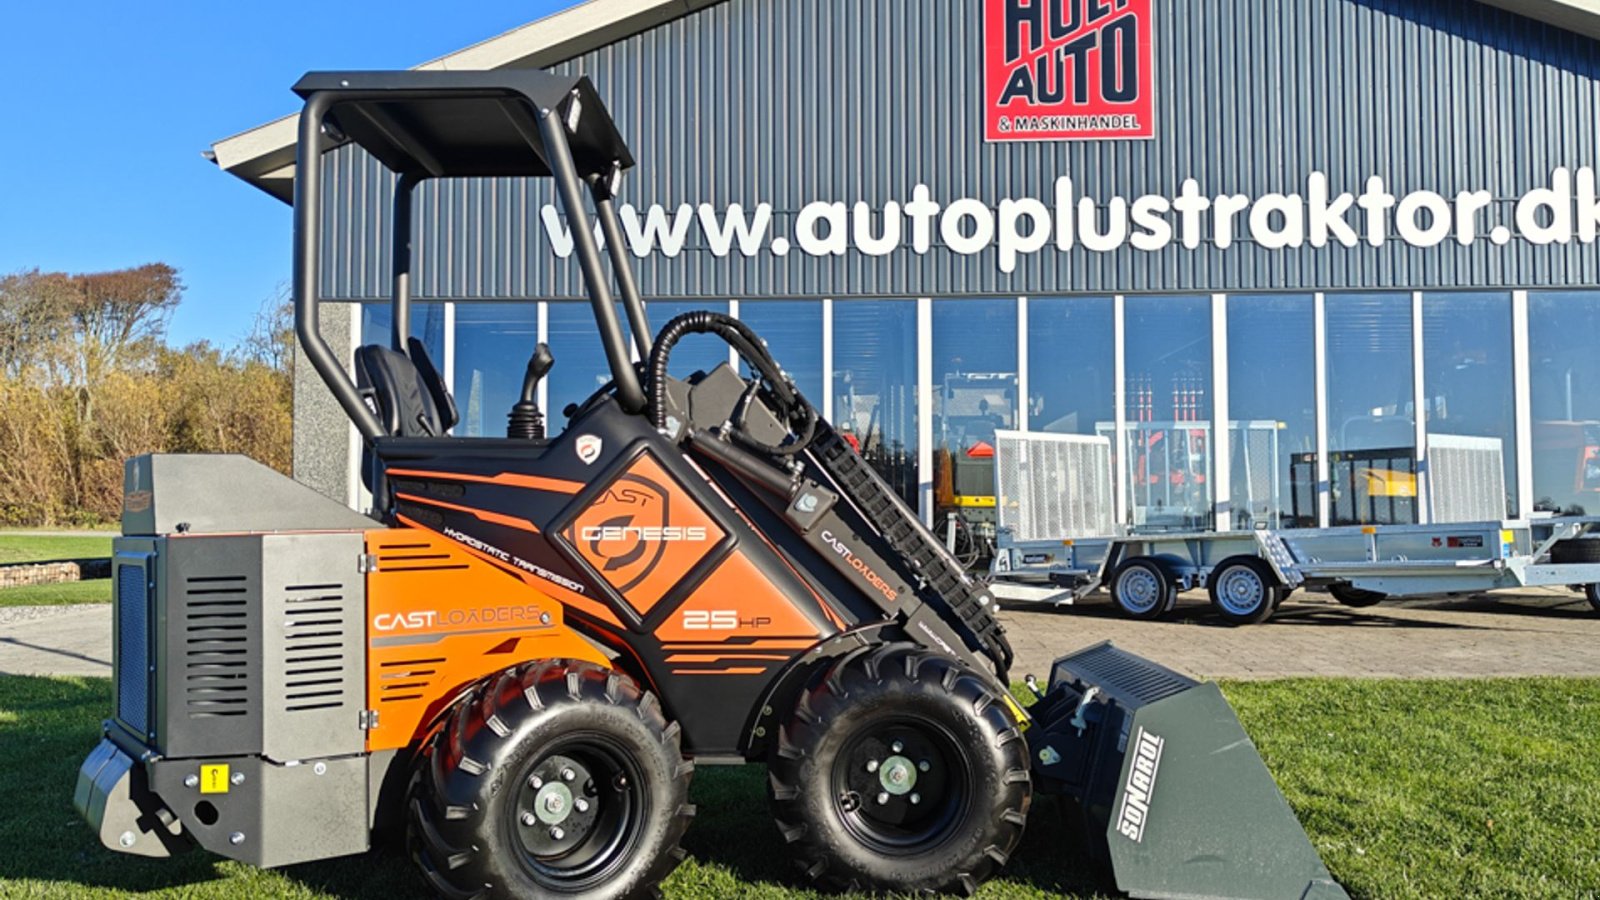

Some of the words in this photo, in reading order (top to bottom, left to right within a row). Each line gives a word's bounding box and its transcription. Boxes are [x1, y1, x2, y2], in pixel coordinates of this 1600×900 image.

[996, 12, 1138, 106] AUTO
[998, 116, 1011, 132] &
[1014, 114, 1140, 131] MASKINHANDEL
[581, 526, 707, 541] GENESIS
[683, 610, 737, 630] 25
[738, 617, 772, 629] HP
[1119, 727, 1162, 841] SONAROL
